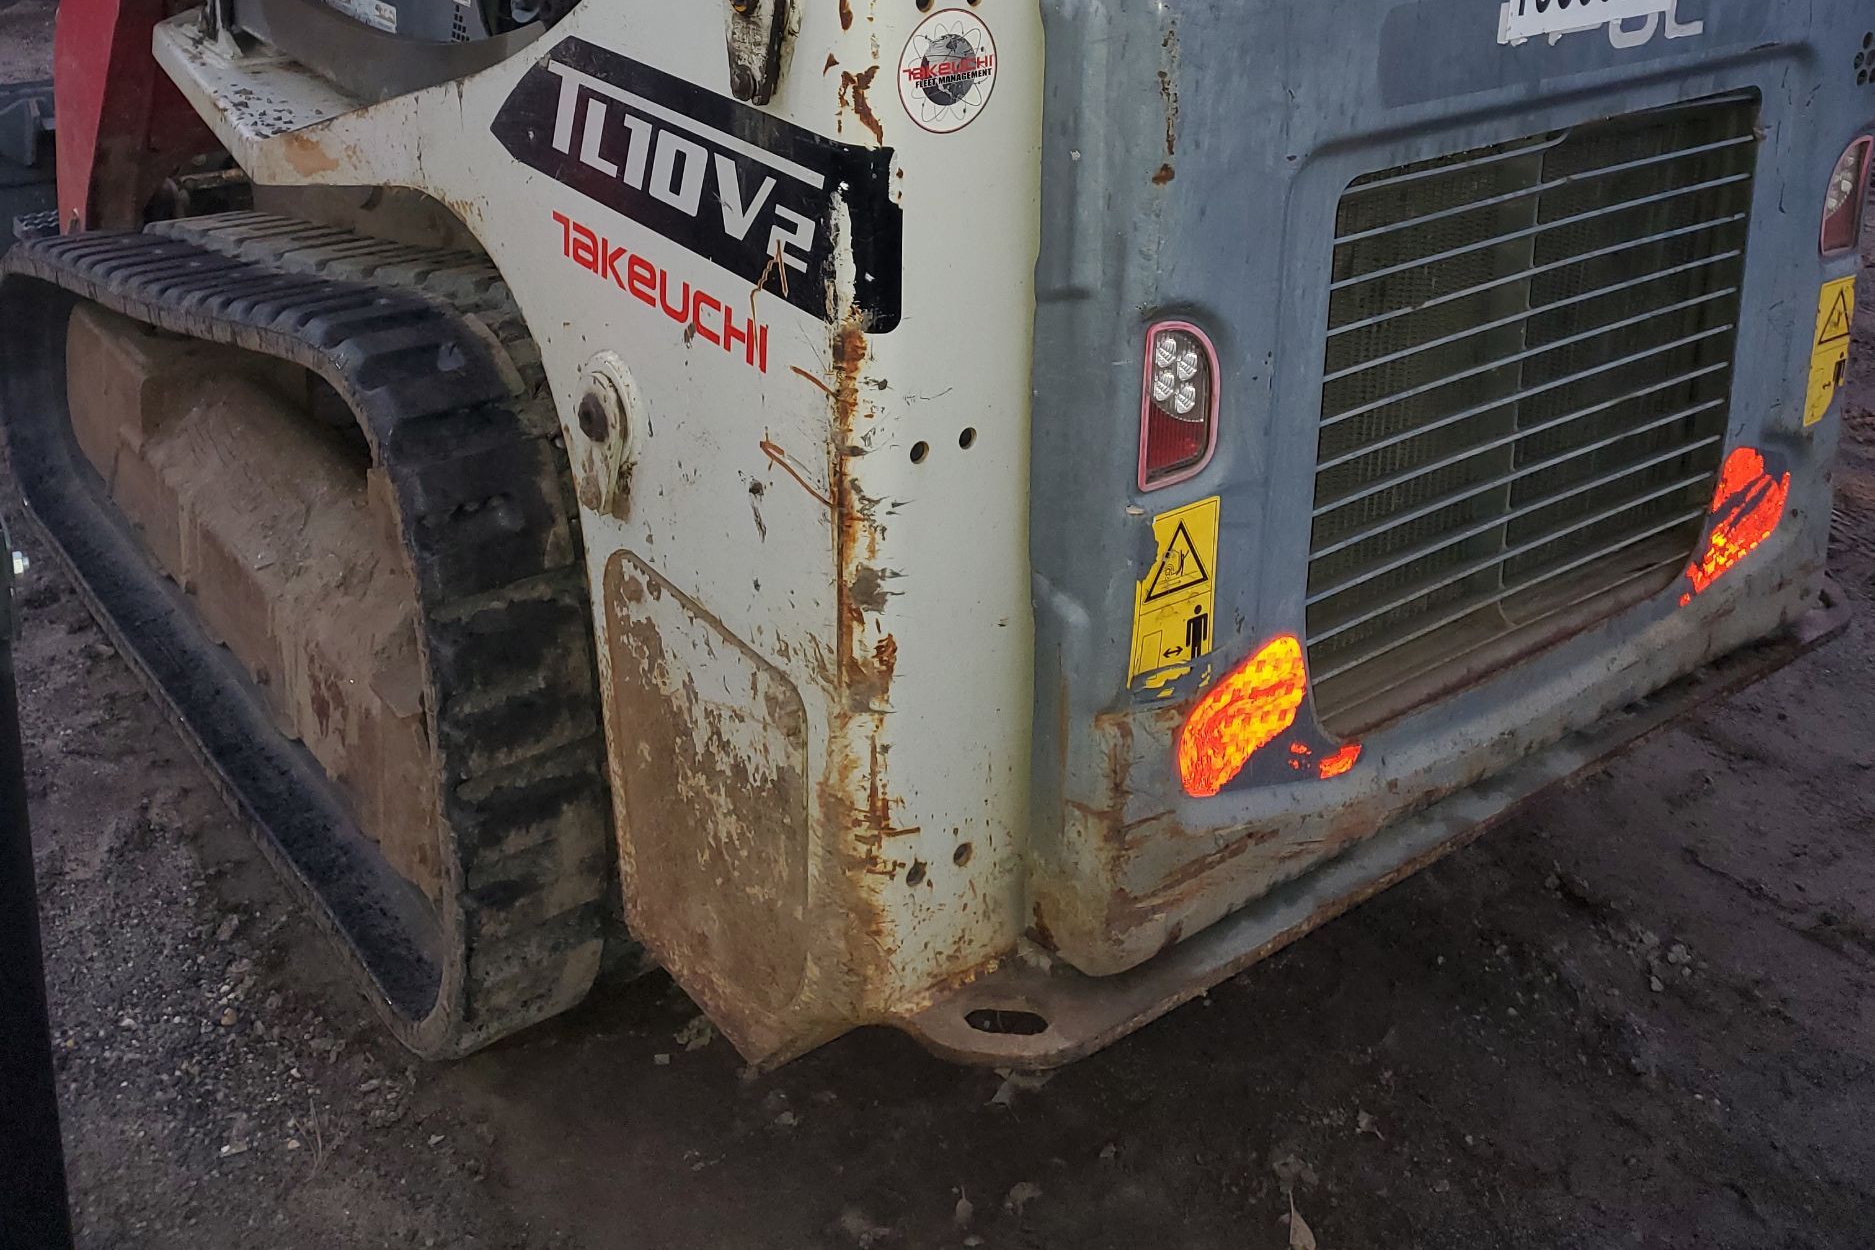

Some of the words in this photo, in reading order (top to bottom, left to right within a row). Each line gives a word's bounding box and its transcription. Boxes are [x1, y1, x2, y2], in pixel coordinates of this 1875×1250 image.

[915, 77, 937, 89] FLEET
[938, 67, 993, 84] MANAGEMENT
[547, 59, 825, 274] TL10V2
